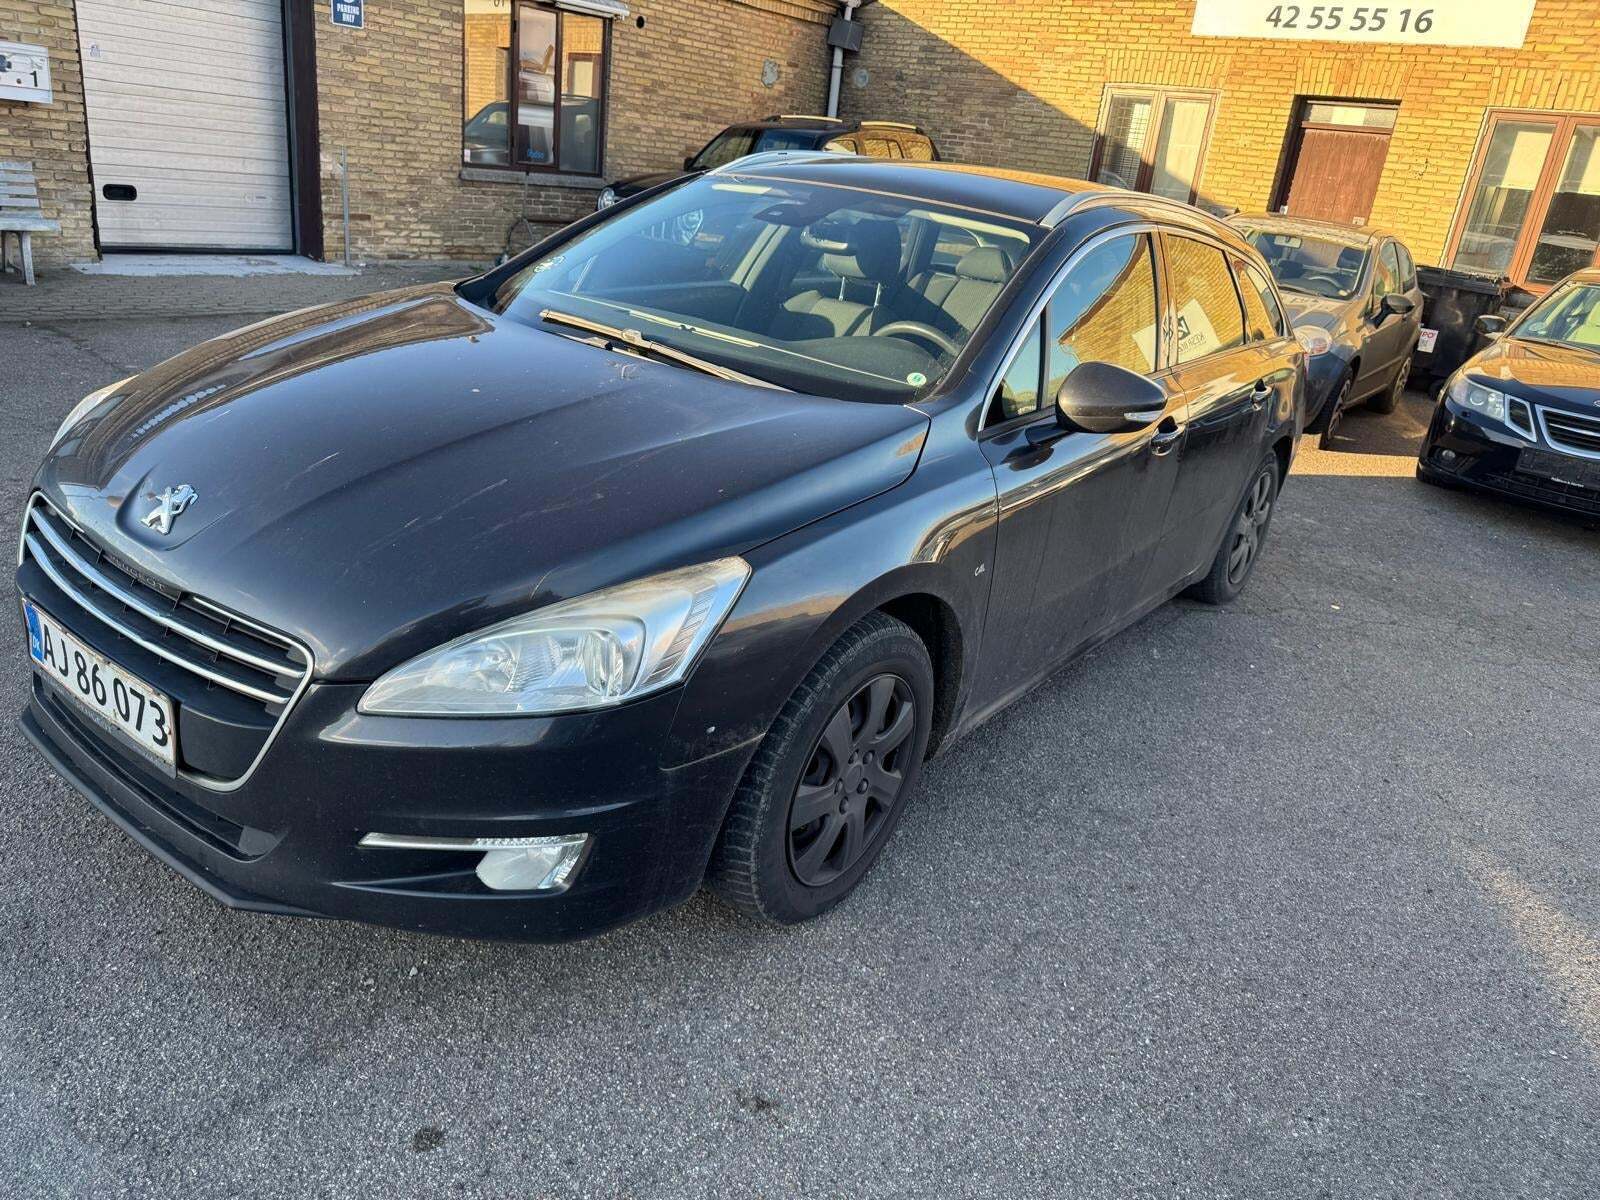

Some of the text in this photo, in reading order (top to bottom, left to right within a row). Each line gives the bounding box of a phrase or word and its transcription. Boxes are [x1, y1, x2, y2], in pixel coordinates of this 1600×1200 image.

[1265, 5, 1434, 34] 42 55 55 16
[32, 637, 41, 651] DK
[43, 623, 69, 677] AJ
[74, 650, 107, 706] 86
[113, 677, 168, 747] 073
